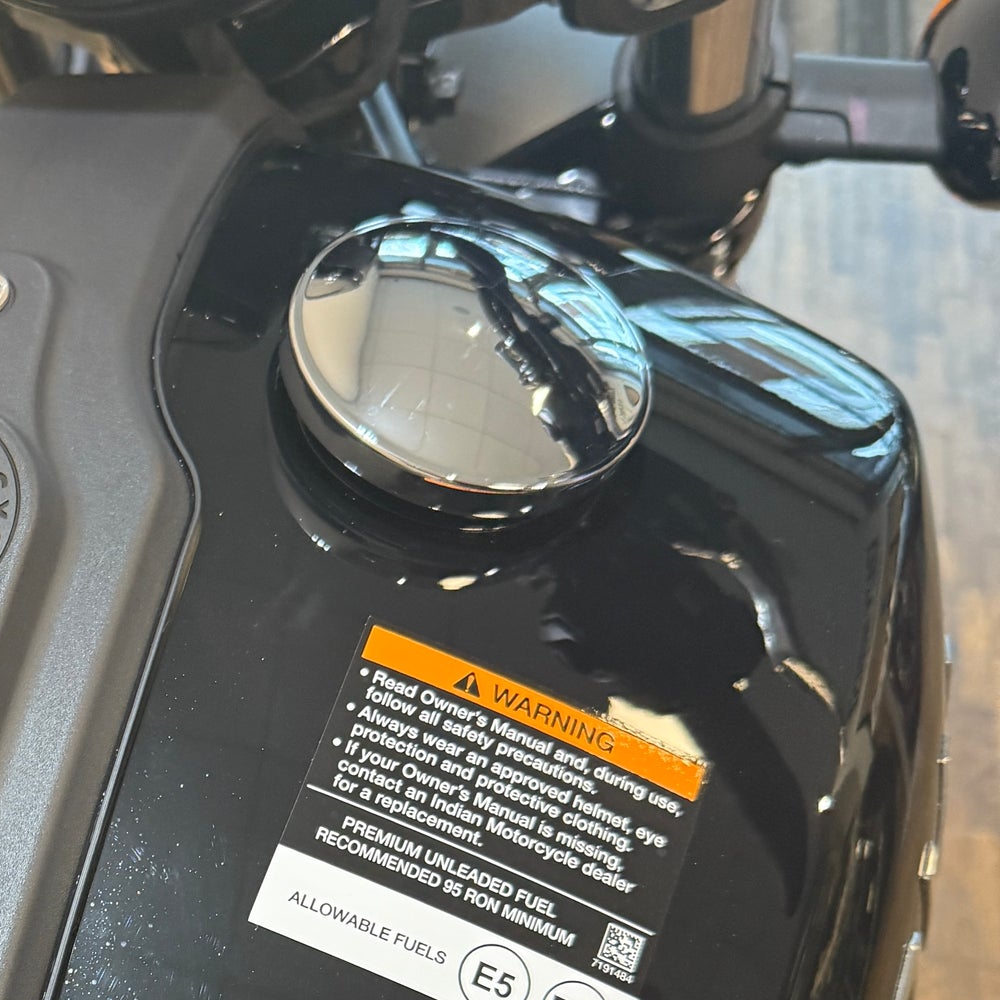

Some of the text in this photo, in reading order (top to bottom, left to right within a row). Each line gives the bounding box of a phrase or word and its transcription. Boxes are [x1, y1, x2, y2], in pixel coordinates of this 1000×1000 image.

[358, 705, 669, 848] Always wear an approved helmet, eye
[365, 686, 598, 795] follow all safety precautions.
[372, 670, 685, 818] Read Owner's Manual and, during use,
[494, 684, 616, 754] WARNING
[332, 773, 484, 847] for a replacement.
[337, 759, 639, 893] contact an Indian Motorcycle dealer
[344, 740, 625, 872] If your Owner's Manual is missing,
[350, 723, 634, 852] protection and protective clothing.
[314, 826, 577, 948] RECOMMENDED 95 RON MINIMUM
[341, 815, 557, 919] PREMIUM UNLEADED FUEL
[288, 891, 391, 941] ALLOWABLE
[393, 932, 447, 965] FUELS
[471, 961, 516, 998] E5
[591, 957, 635, 984] 7191484
